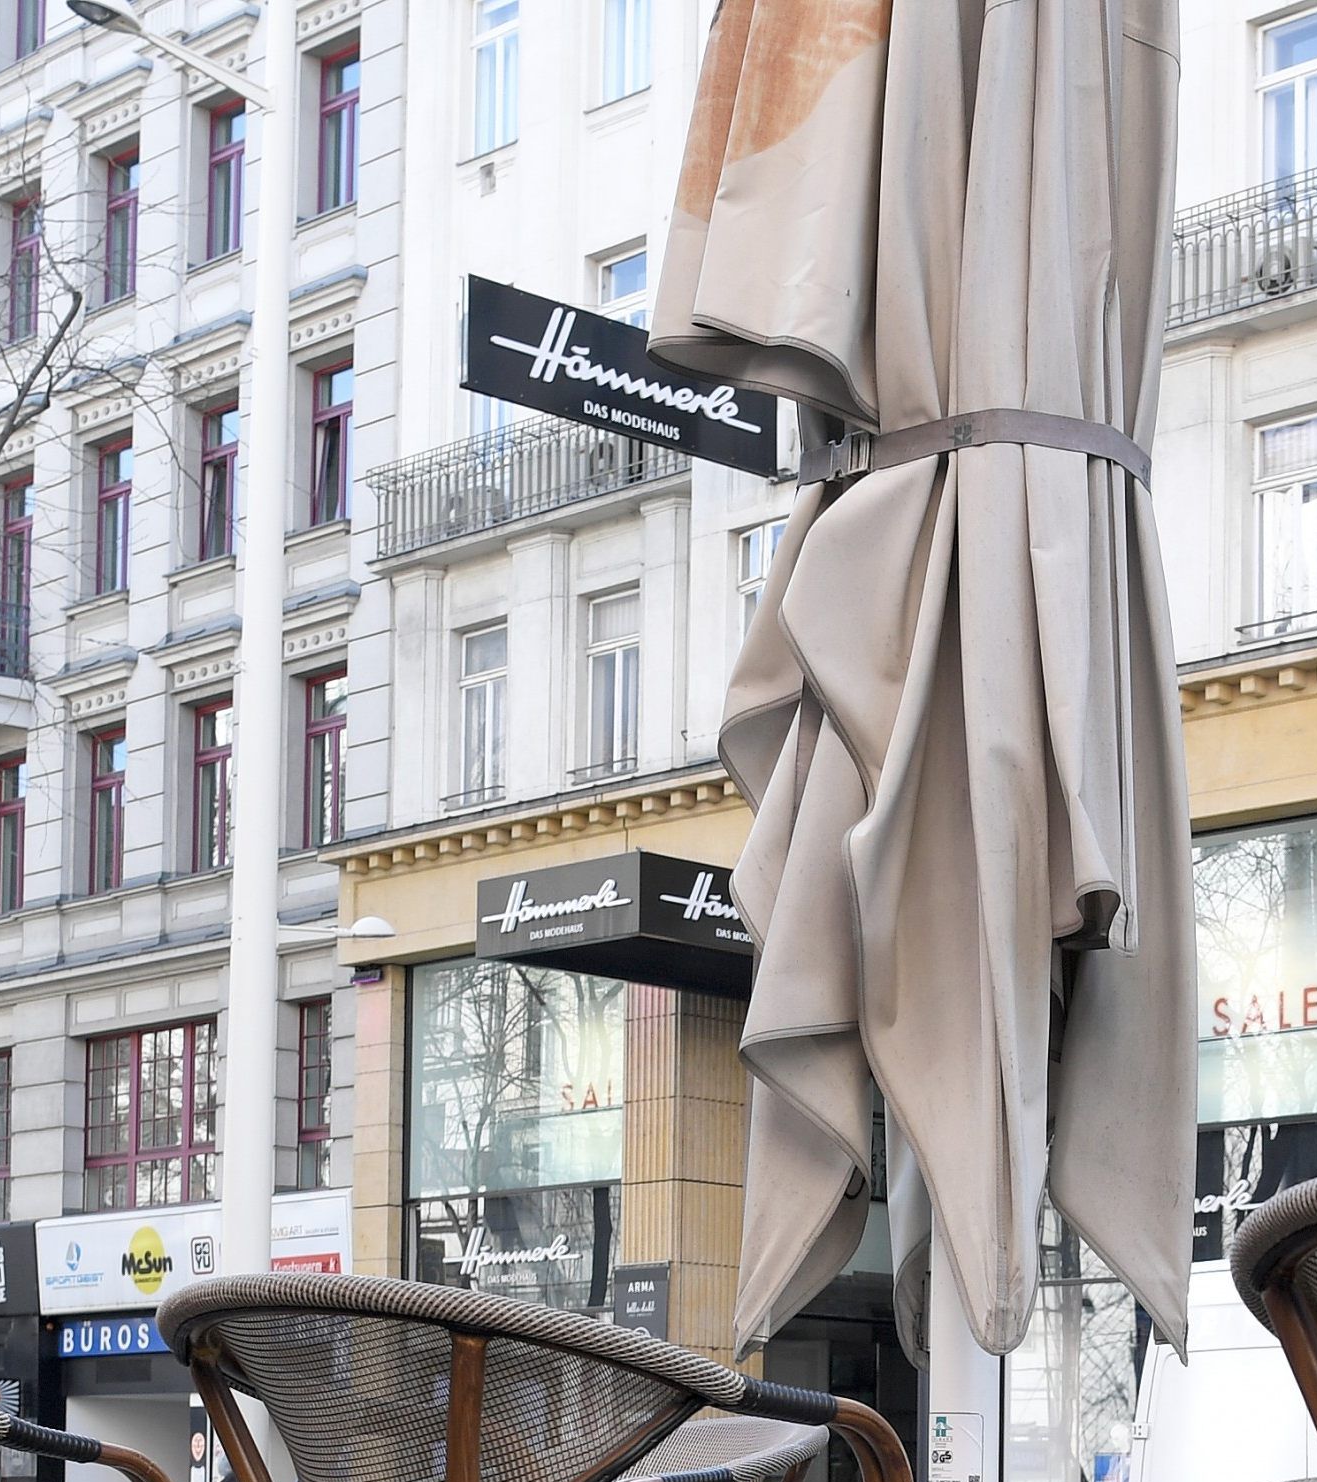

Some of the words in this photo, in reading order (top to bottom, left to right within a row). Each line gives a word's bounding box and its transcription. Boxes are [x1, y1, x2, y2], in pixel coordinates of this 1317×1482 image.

[584, 400, 608, 419] DAS
[611, 409, 681, 441] MODEHAUS
[529, 929, 543, 941] DAS
[545, 923, 584, 938] MODEHAUS
[716, 928, 731, 939] DAS
[121, 1250, 173, 1276] McSun
[628, 1280, 655, 1293] ARMA
[63, 1321, 150, 1353] BÜROS
